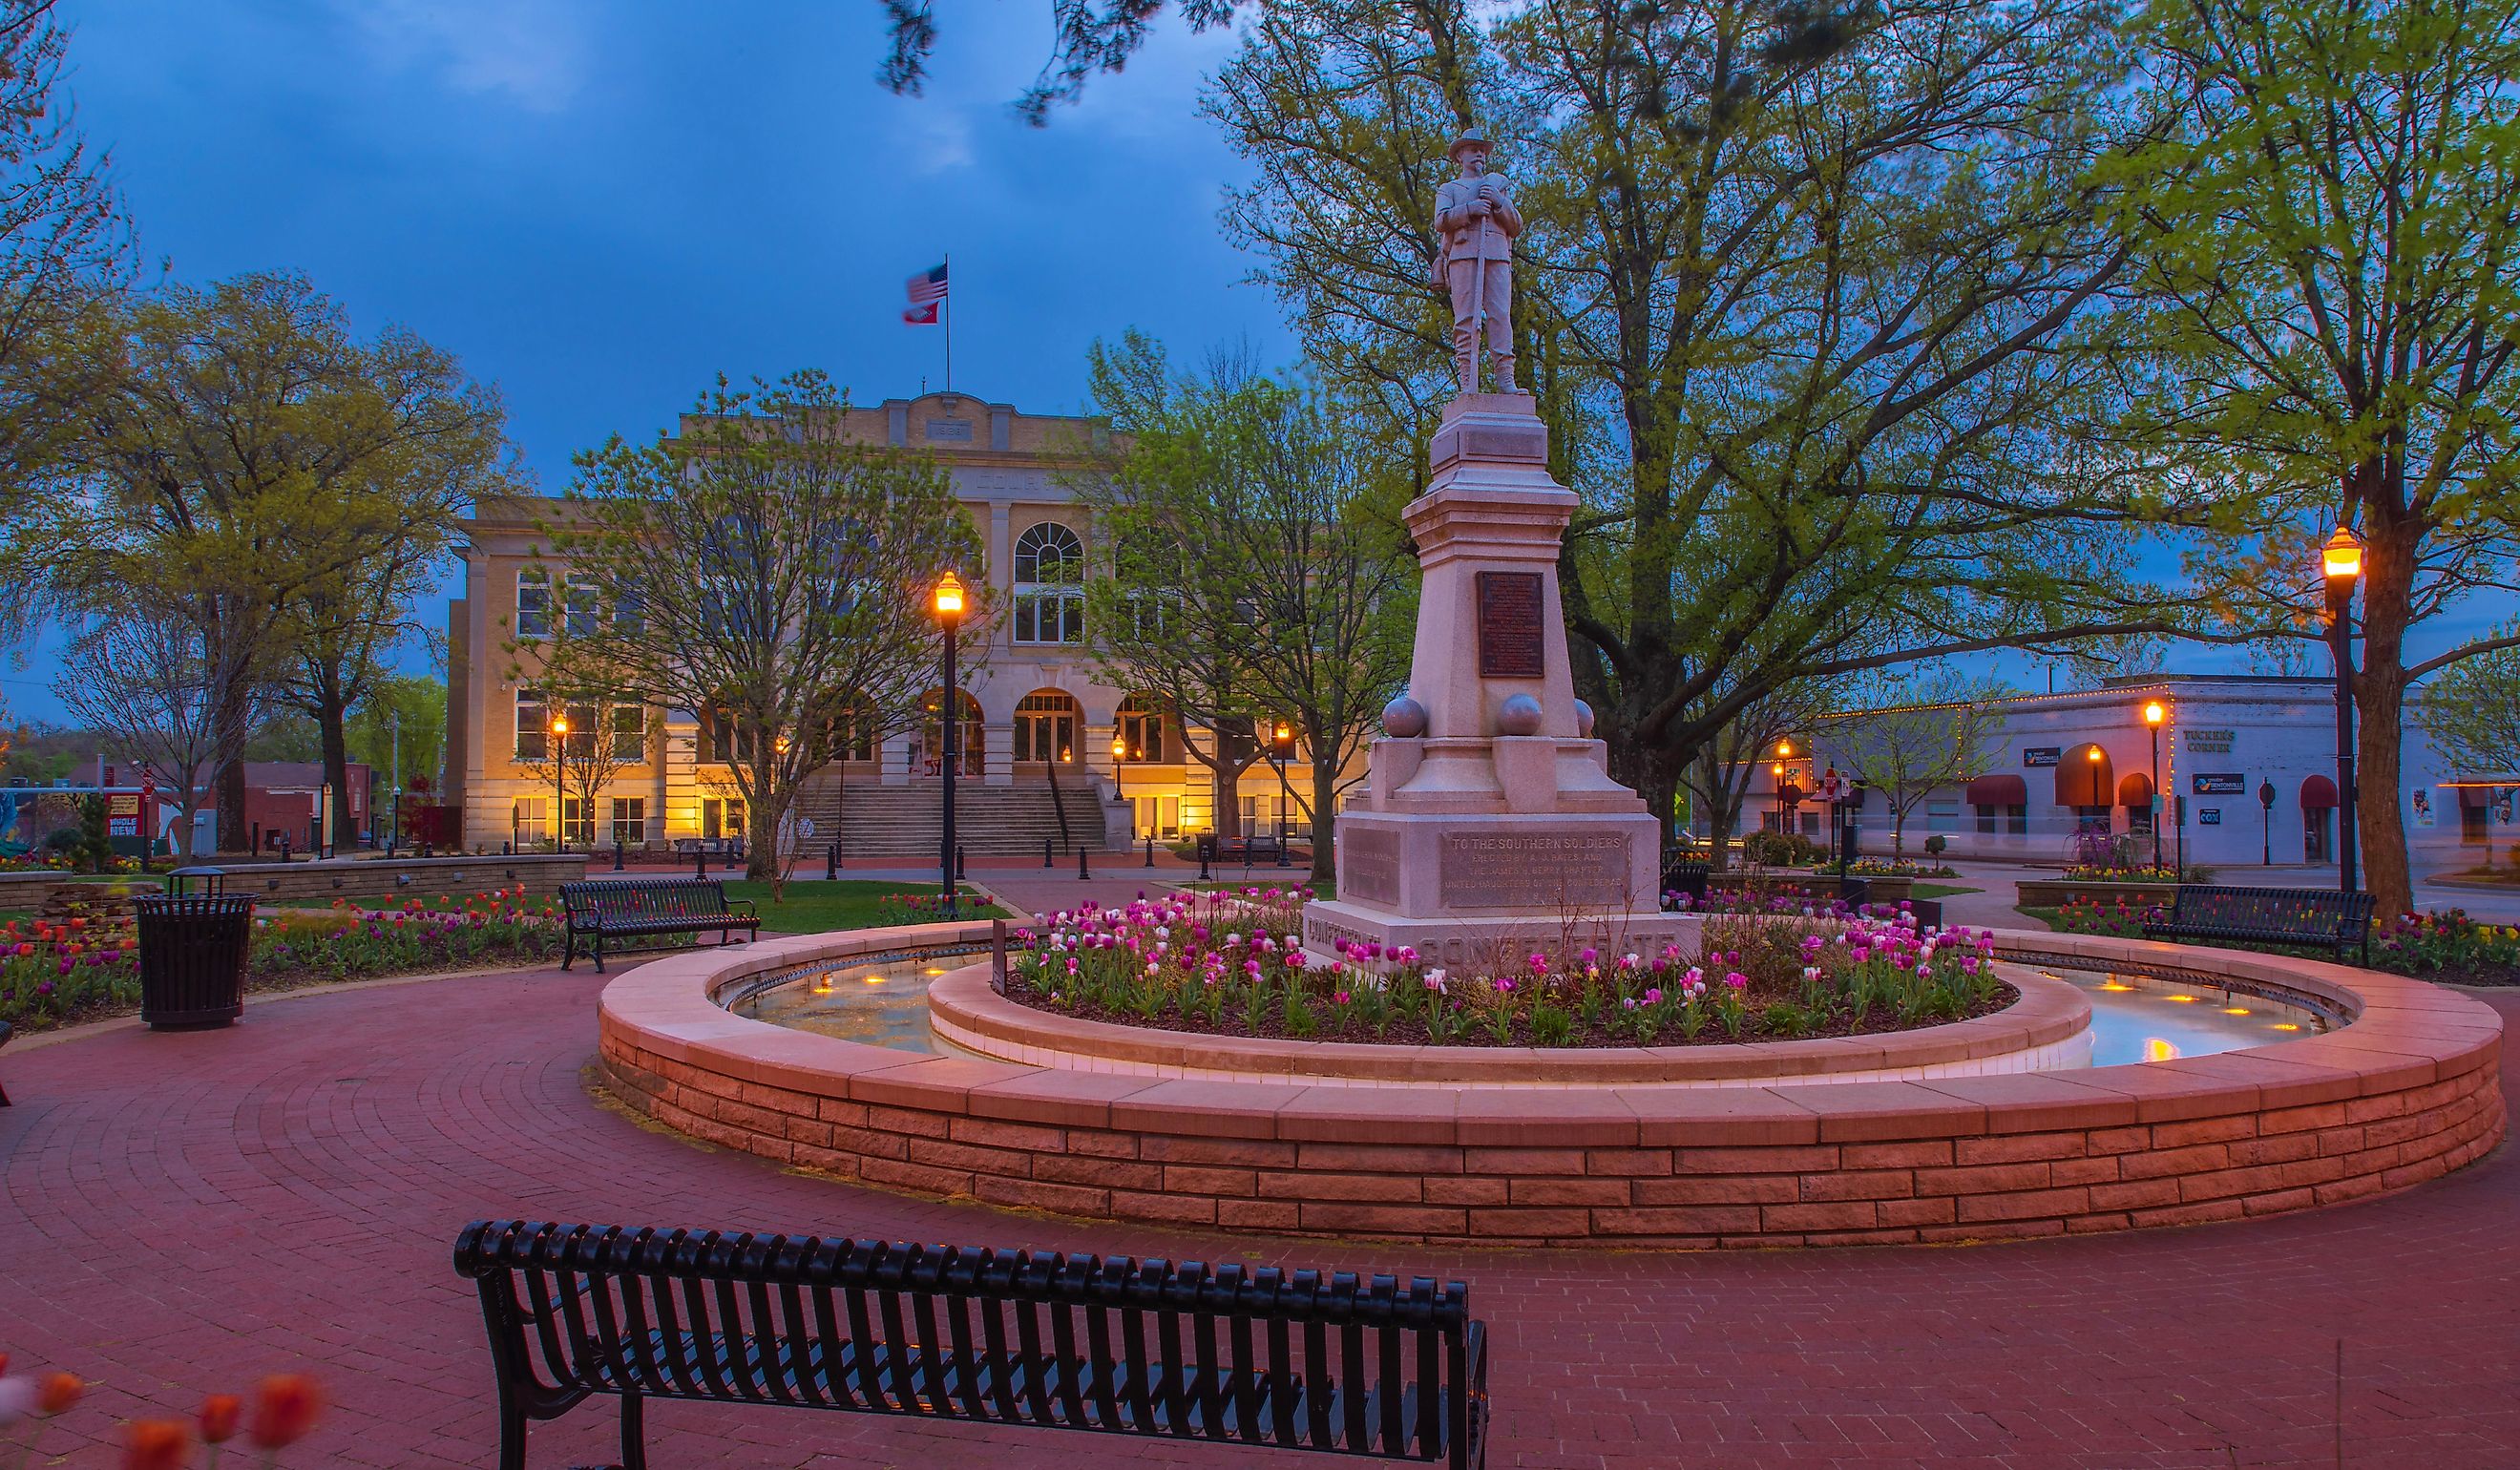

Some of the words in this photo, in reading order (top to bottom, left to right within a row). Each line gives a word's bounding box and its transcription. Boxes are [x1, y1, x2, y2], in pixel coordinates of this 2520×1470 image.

[2183, 729, 2235, 742] TUCKER'S
[2187, 743, 2231, 752] CORNER
[2200, 813, 2219, 823] COX
[110, 826, 136, 836] NEW
[1452, 837, 1469, 850] TO
[1472, 837, 1496, 850] THE
[1496, 837, 1561, 850] SOUTHERN
[1564, 837, 1621, 850] SOLDIERS
